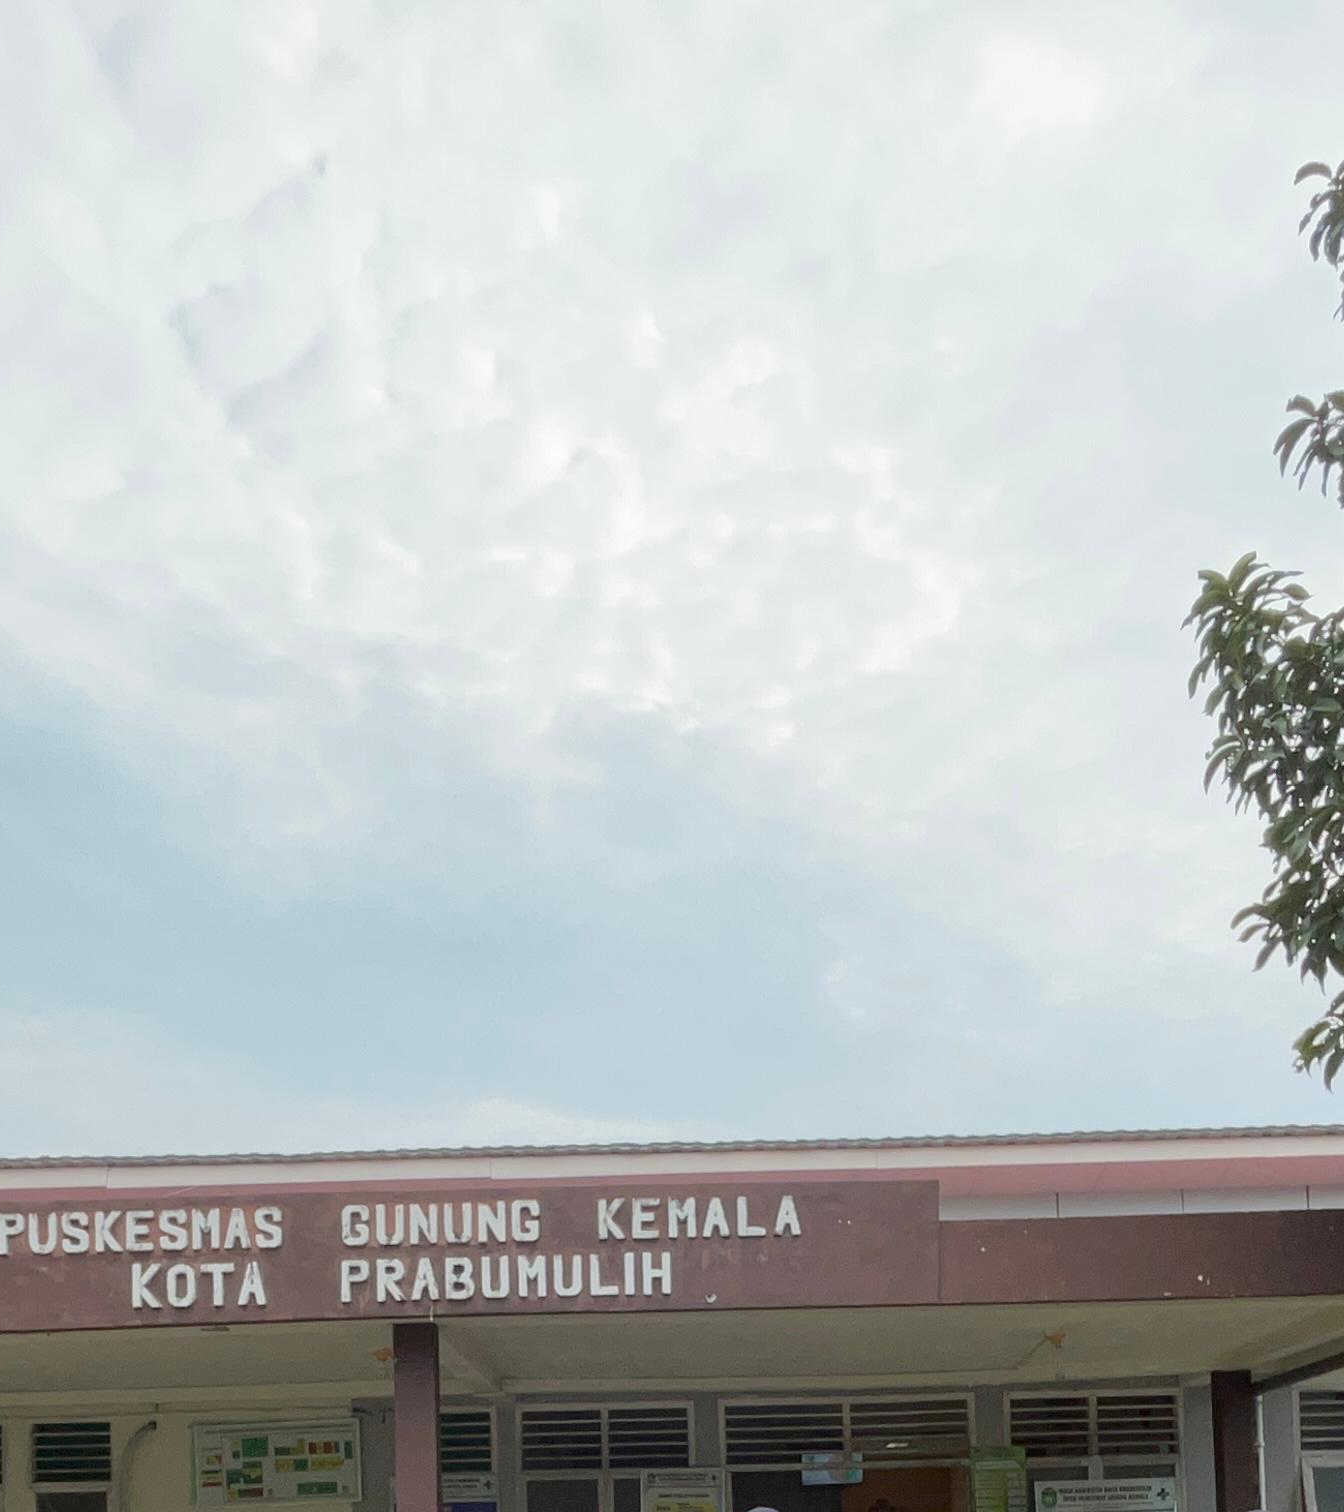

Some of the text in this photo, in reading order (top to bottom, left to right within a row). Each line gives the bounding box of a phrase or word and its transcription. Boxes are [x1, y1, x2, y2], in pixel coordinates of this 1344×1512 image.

[341, 1199, 541, 1247] GUNUNG
[597, 1195, 802, 1240] KEMALA
[131, 1251, 671, 1308] KOTA PRABUMULIH
